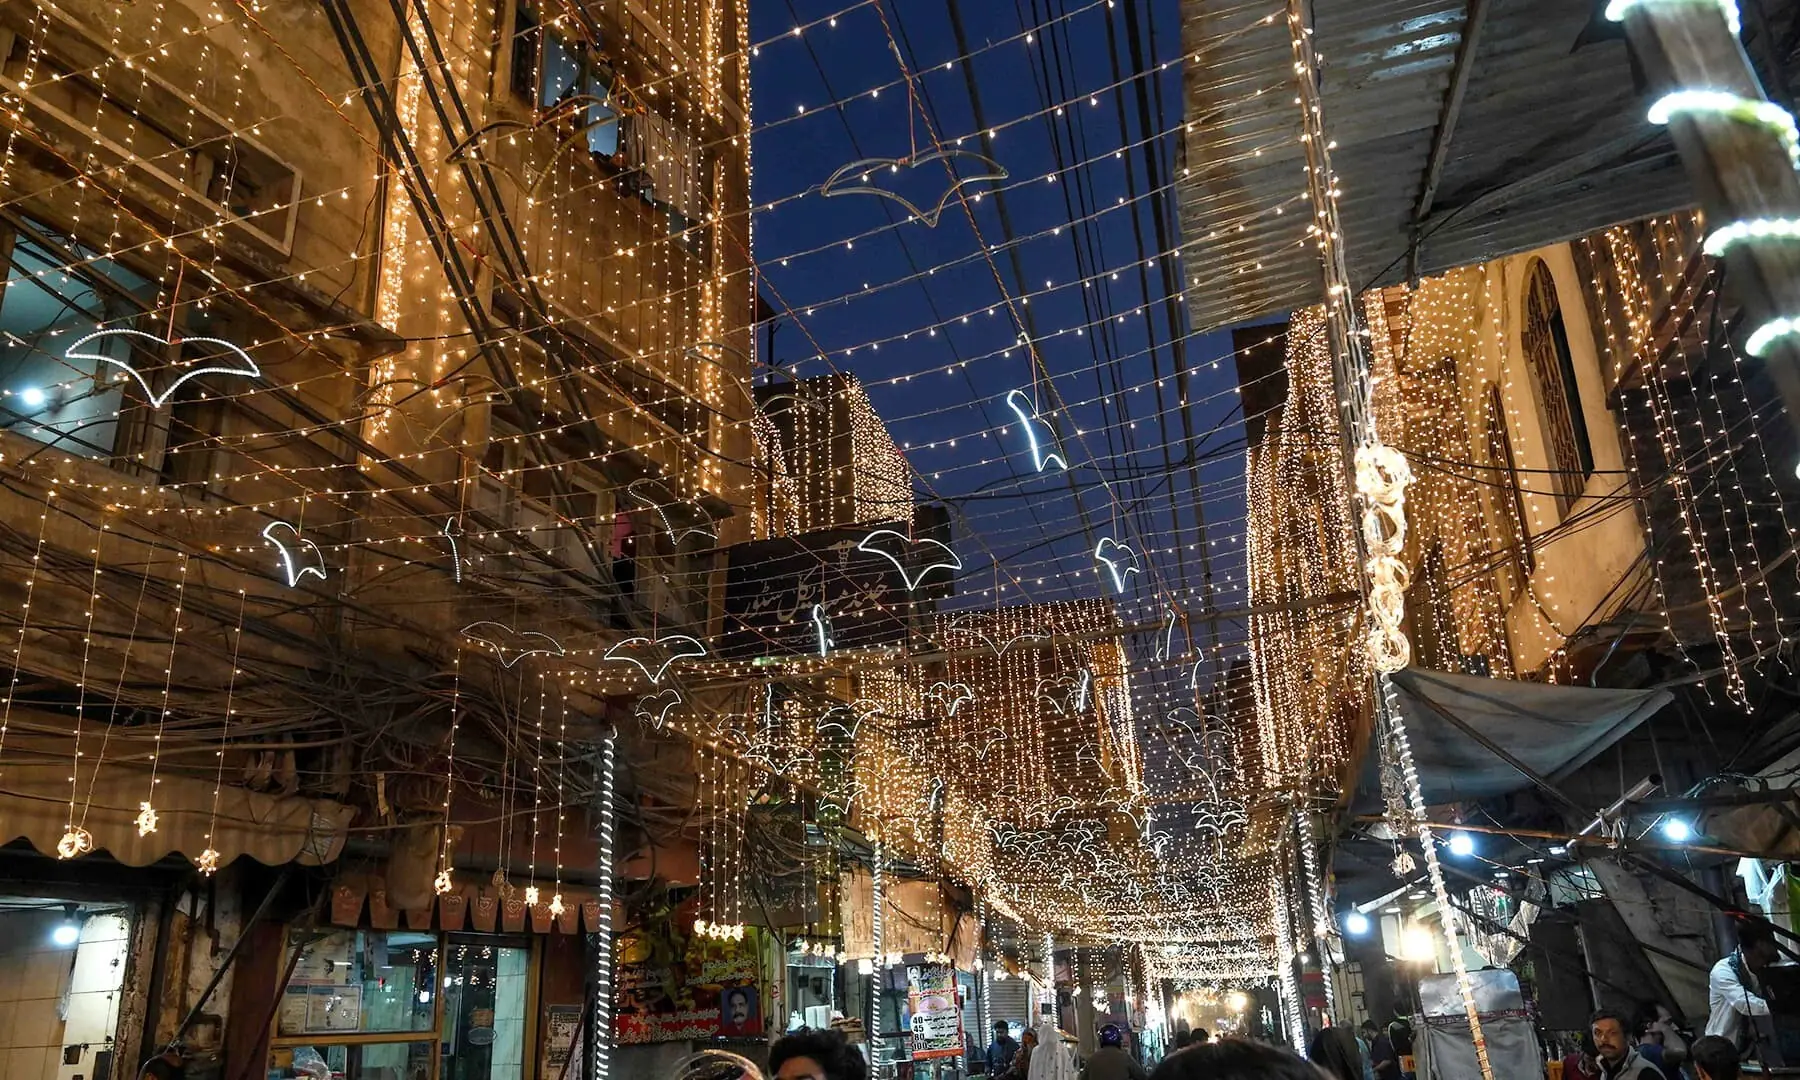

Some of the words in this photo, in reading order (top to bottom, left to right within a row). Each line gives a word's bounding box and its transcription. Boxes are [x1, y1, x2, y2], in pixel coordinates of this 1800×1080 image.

[912, 1016, 923, 1024] 40
[913, 1025, 924, 1033] 45
[914, 1033, 925, 1041] 80
[913, 1042, 928, 1050] 100
